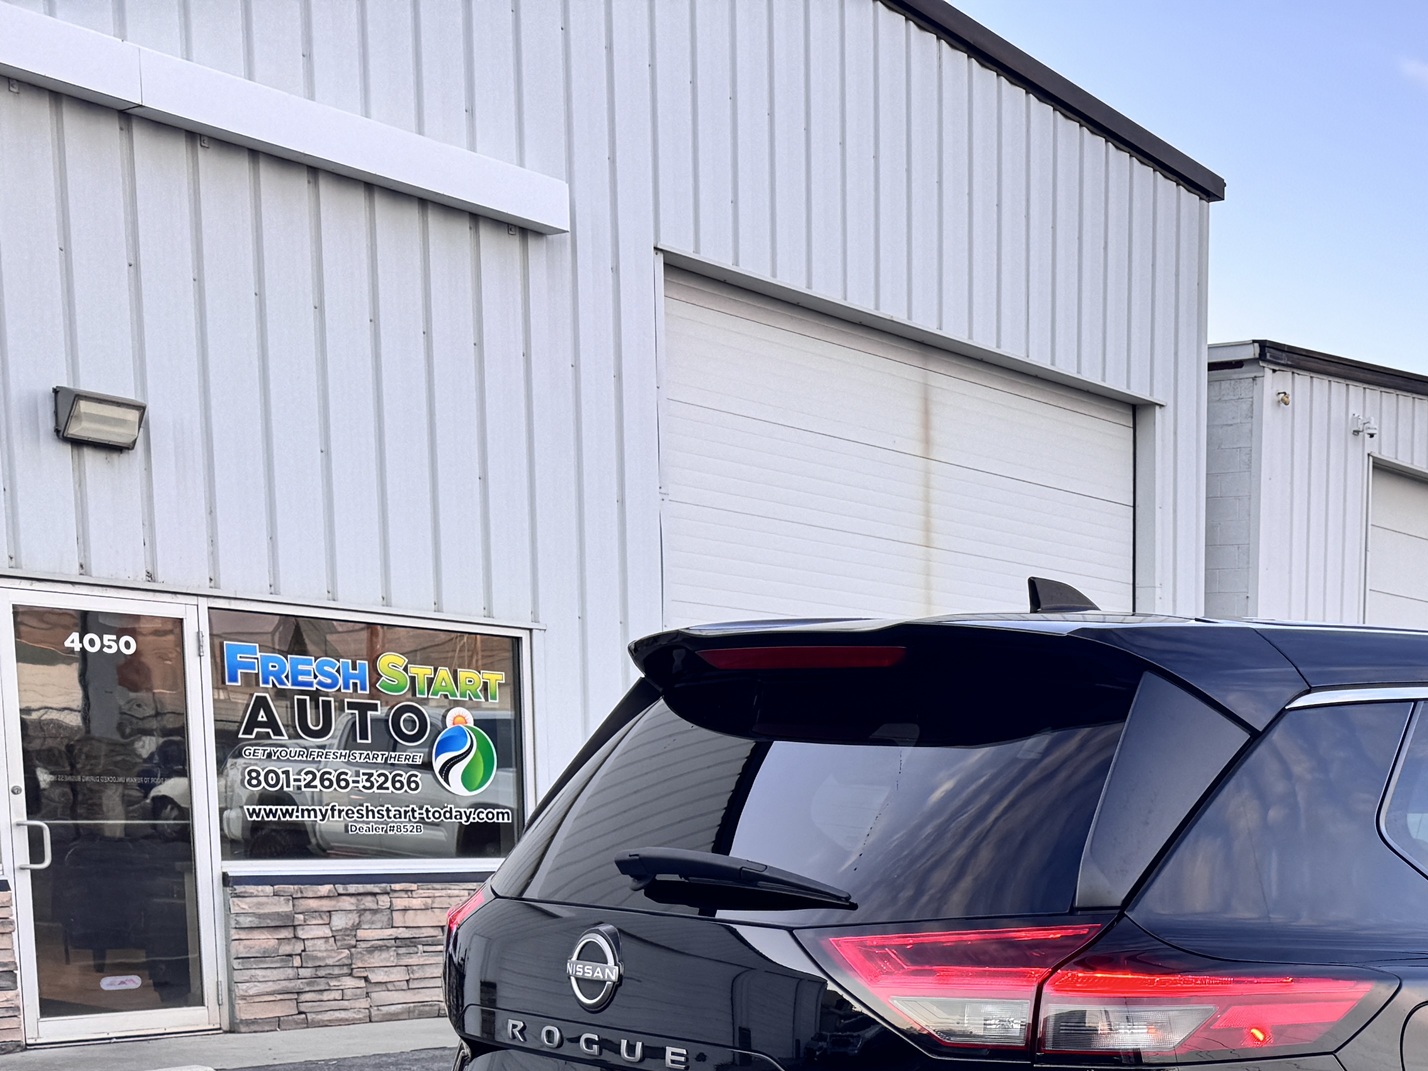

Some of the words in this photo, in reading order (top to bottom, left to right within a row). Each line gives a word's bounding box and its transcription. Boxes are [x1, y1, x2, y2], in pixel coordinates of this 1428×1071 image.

[64, 632, 137, 655] 4050
[223, 640, 369, 694] FRESH
[376, 652, 506, 702] START
[238, 693, 431, 746] AUTO
[242, 746, 270, 759] GET
[270, 748, 307, 760] YOUR
[308, 750, 349, 762] FRESH
[350, 751, 388, 763] START
[388, 752, 424, 764] HERE!
[244, 766, 423, 793] 801-266-3266
[244, 803, 511, 825] www.myfreshstart-today.com
[349, 823, 386, 834] Dealer
[388, 824, 424, 834] #852B
[567, 962, 616, 980] NISSAN
[507, 1019, 688, 1069] ROGUE
